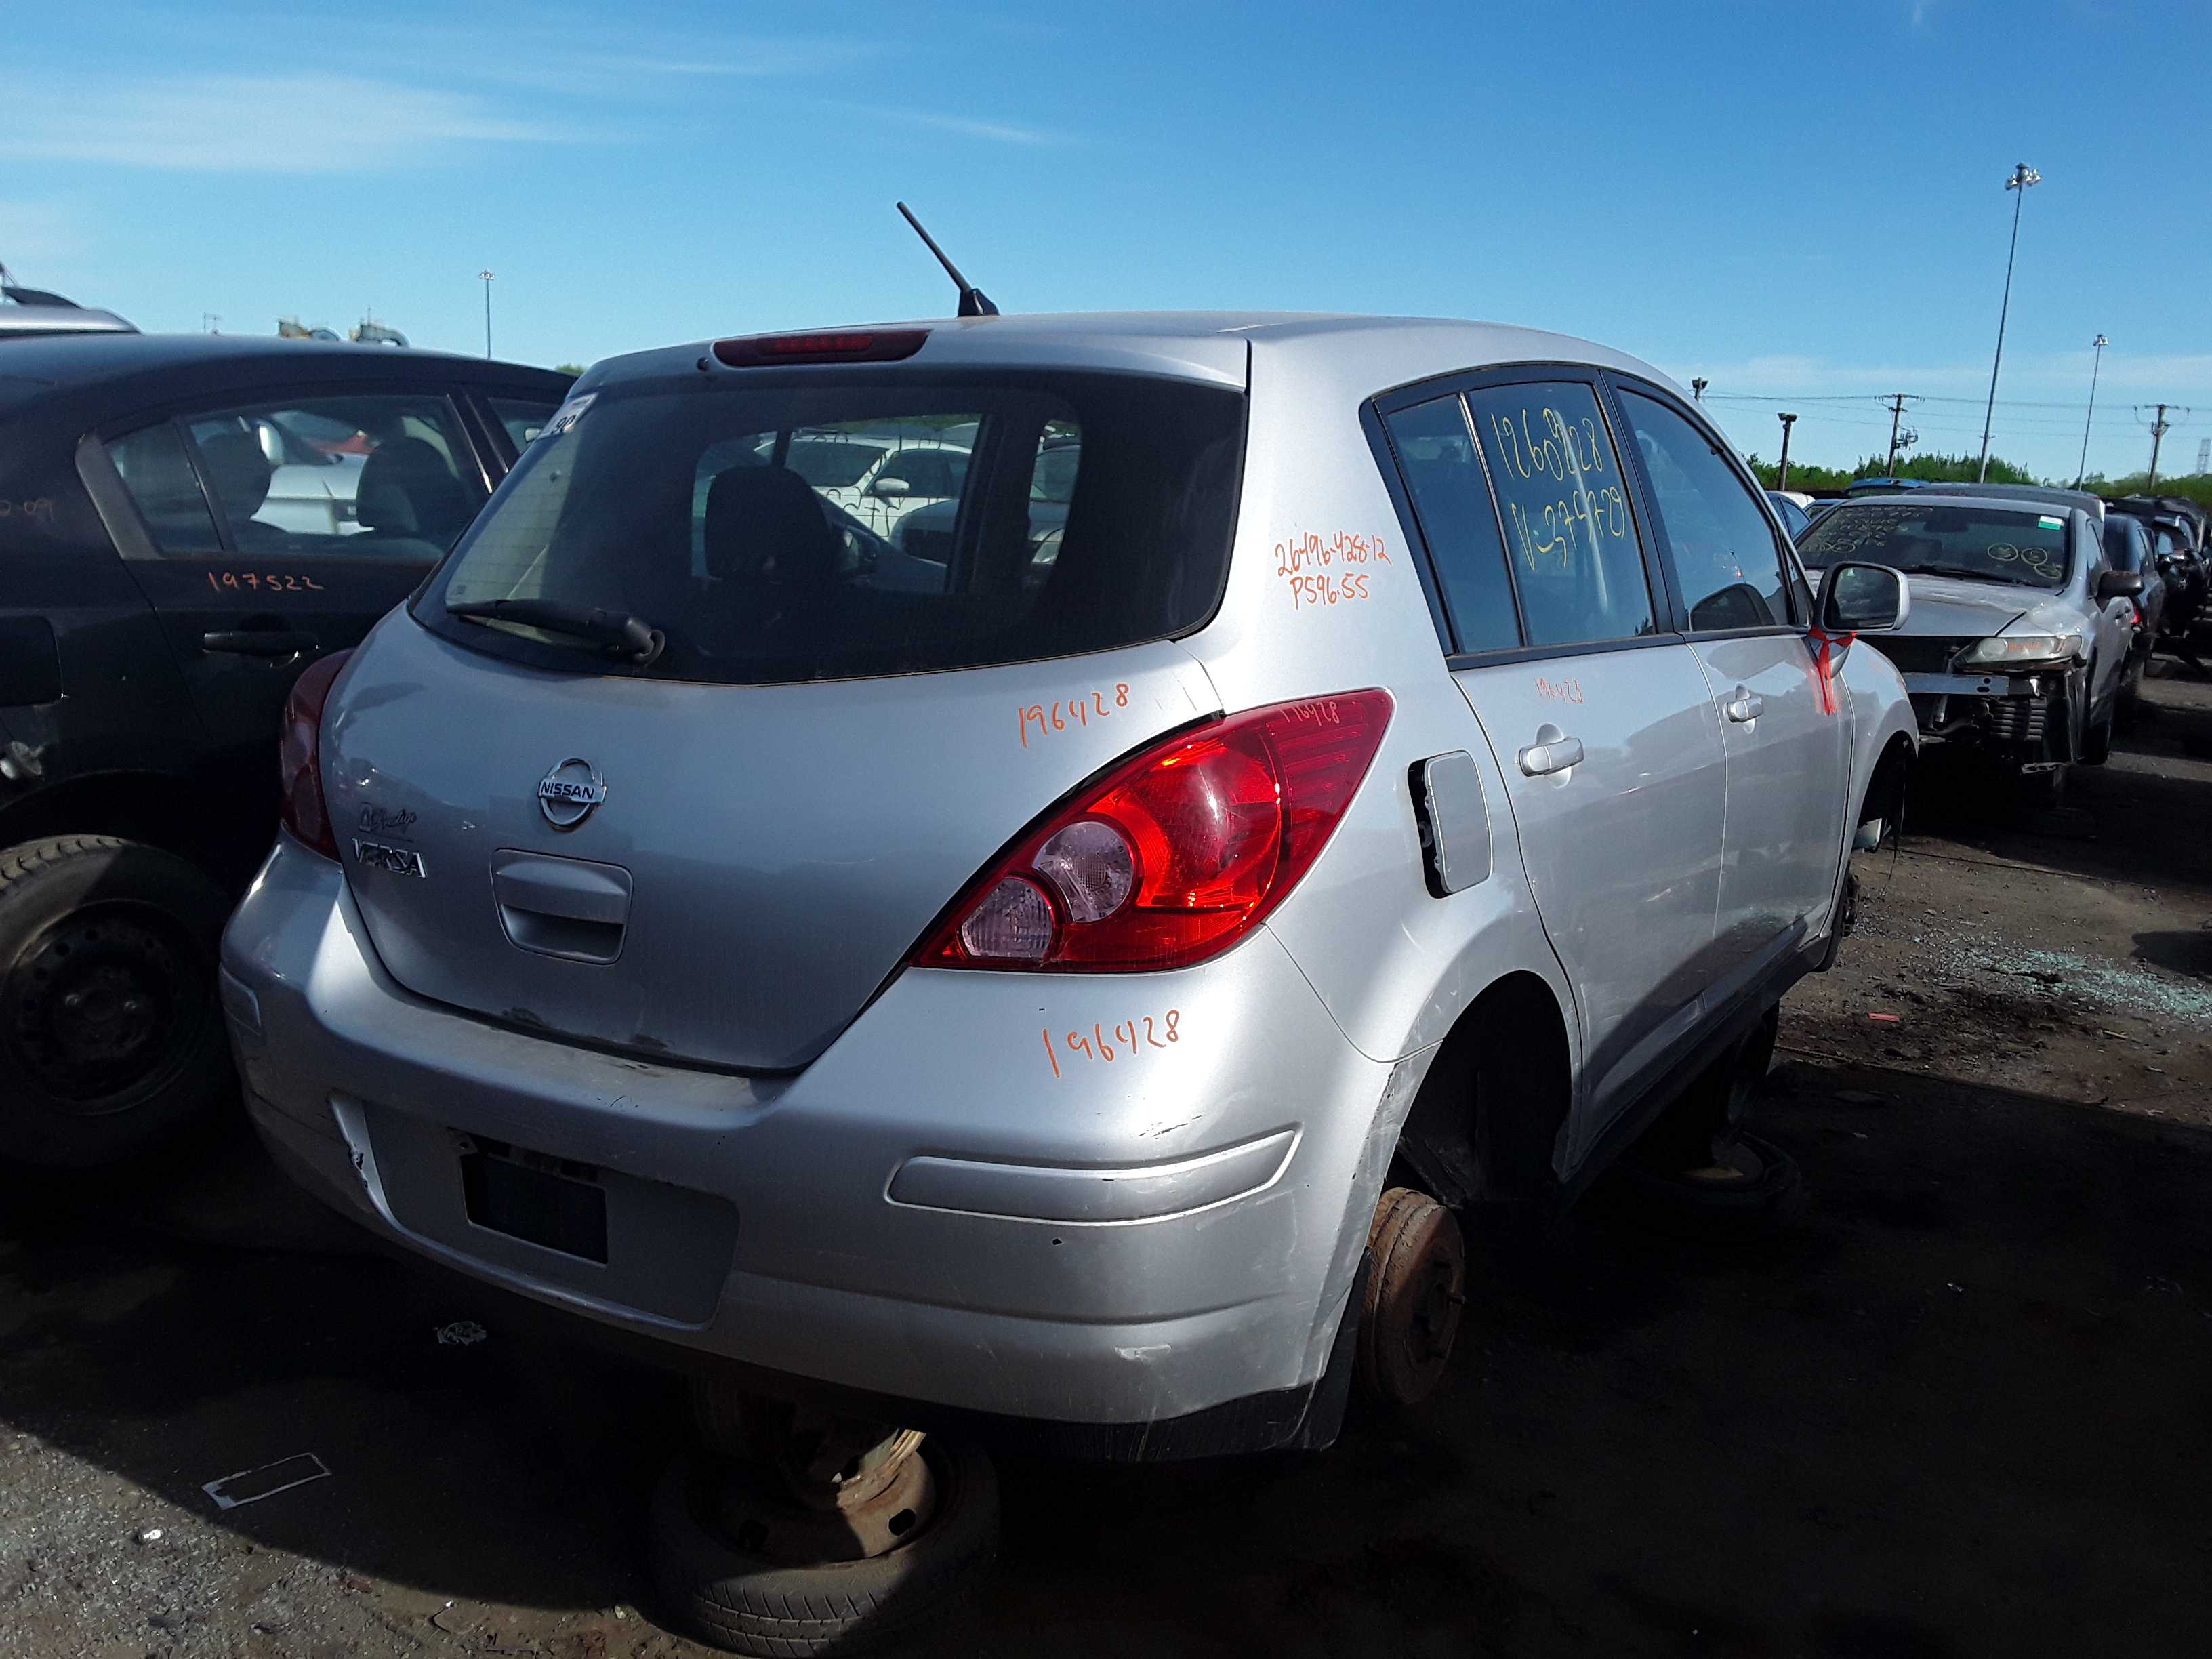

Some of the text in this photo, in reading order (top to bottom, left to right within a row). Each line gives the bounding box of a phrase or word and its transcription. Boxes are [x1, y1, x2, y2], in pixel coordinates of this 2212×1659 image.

[207, 571, 325, 592] 197522
[1019, 682, 1129, 748] 196428
[541, 781, 595, 799] NISSAN
[1043, 1010, 1180, 1078] 196428
